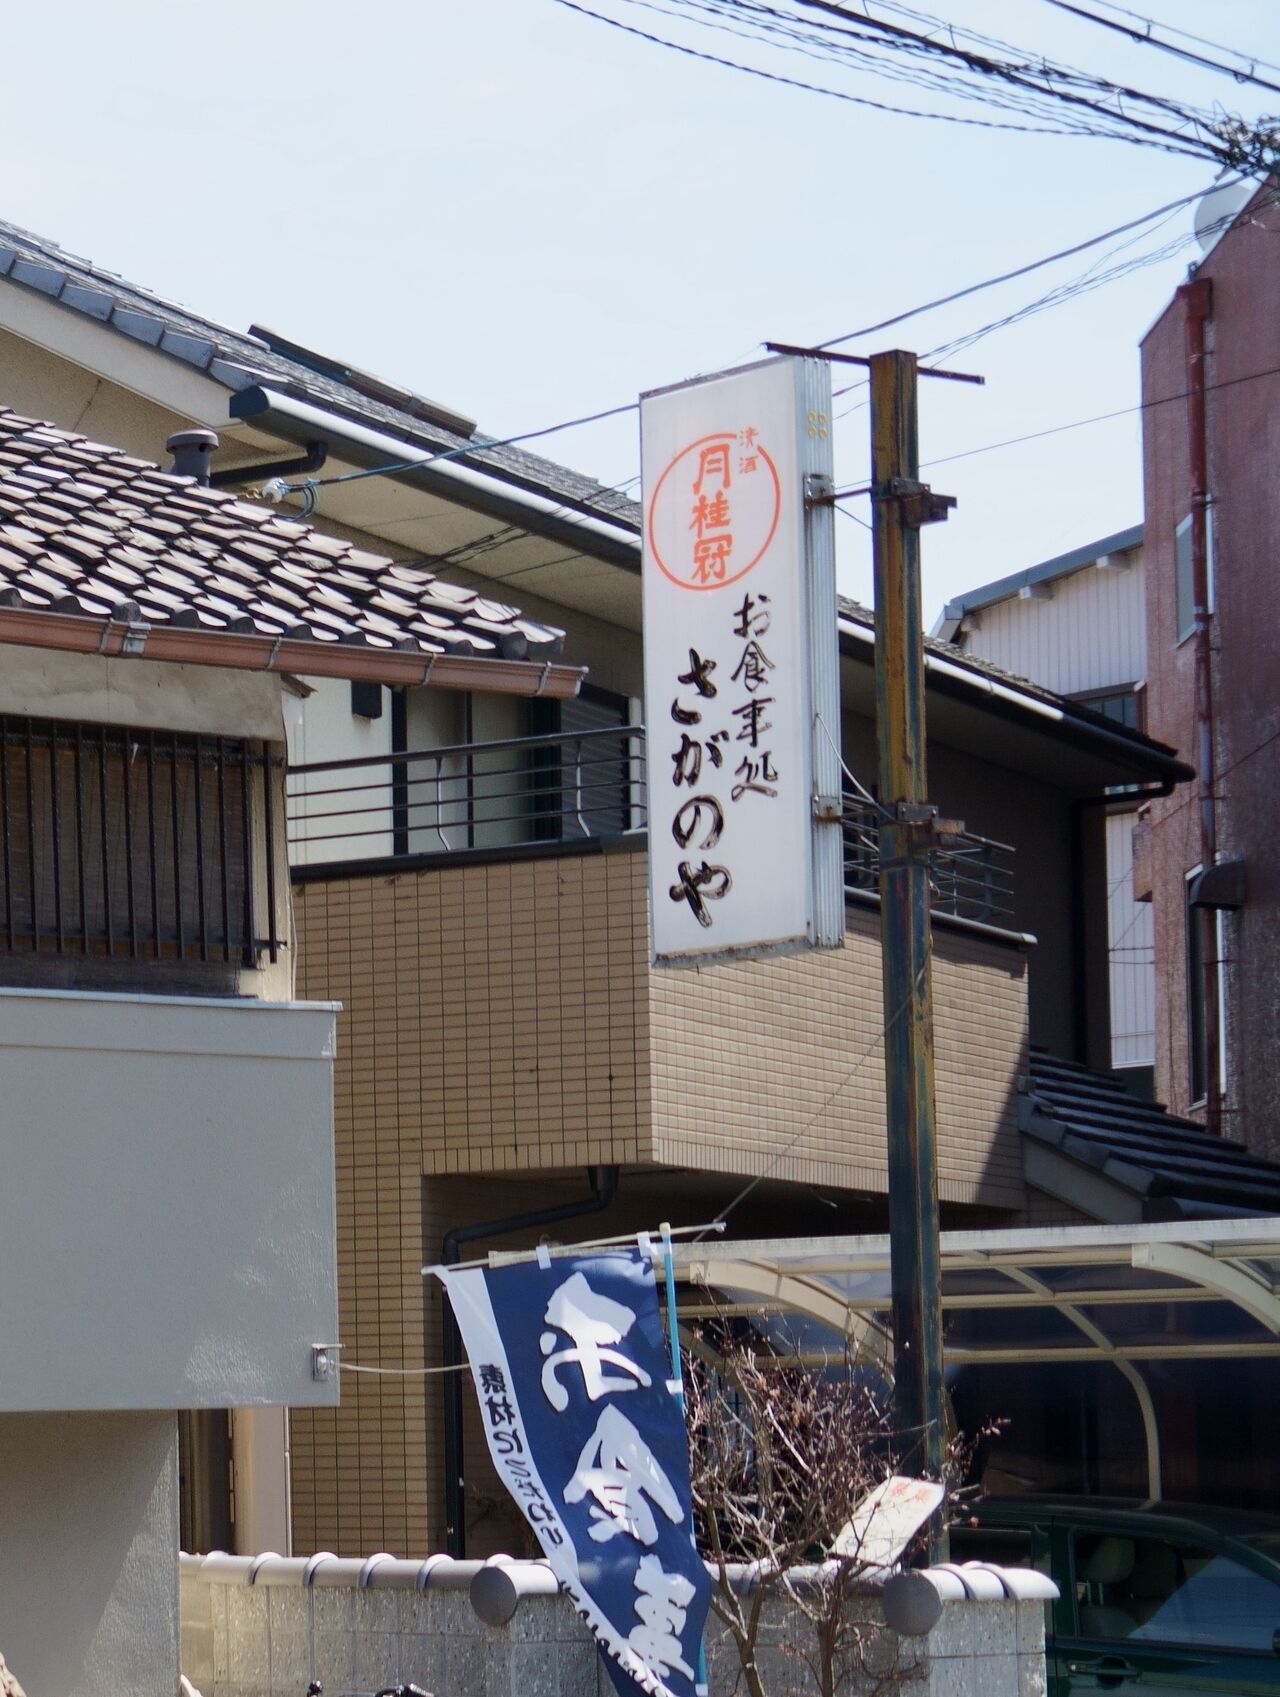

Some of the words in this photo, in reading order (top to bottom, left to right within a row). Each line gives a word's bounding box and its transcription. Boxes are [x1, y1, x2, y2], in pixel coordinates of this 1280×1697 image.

[689, 444, 732, 585] 月桂冠
[739, 426, 760, 474] 清酒
[731, 592, 779, 802] お食事処
[669, 648, 733, 928] さがのや
